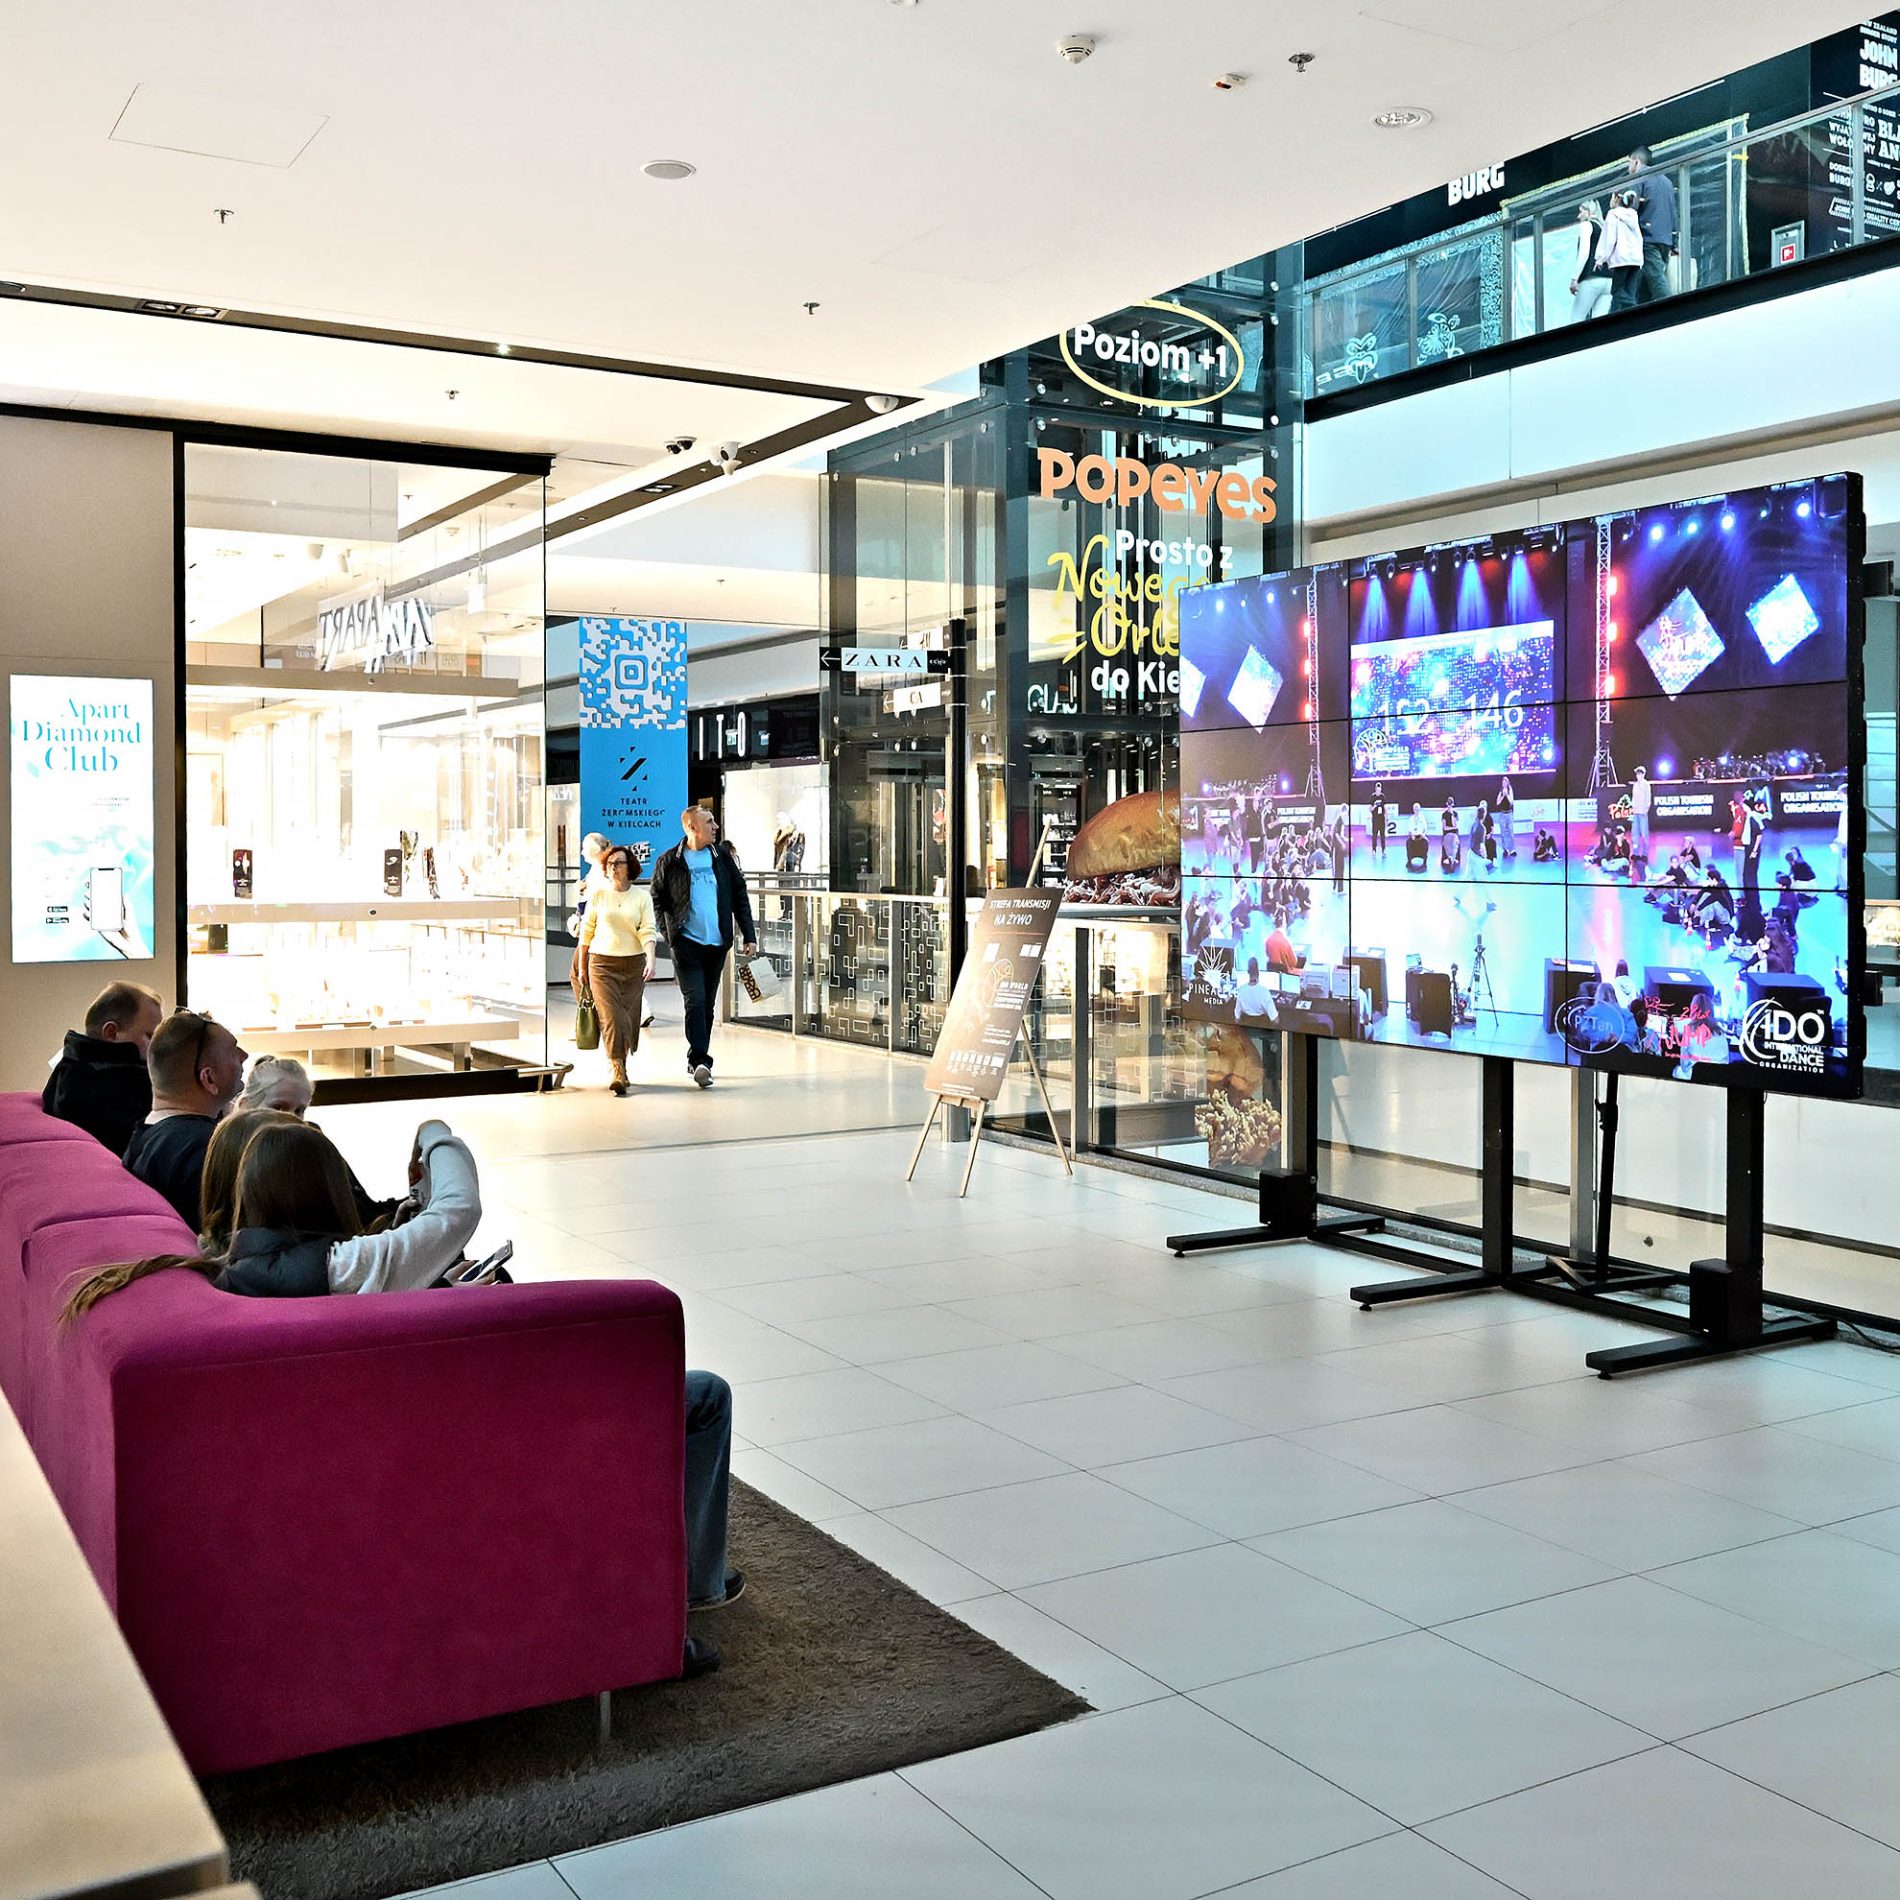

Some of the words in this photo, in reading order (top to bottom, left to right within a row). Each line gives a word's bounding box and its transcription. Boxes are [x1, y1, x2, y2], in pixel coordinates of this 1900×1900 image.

[1859, 38, 1898, 71] JOHN
[1447, 161, 1505, 207] BURG
[1074, 322, 1190, 373] Poziom
[1197, 344, 1227, 378] +1
[1115, 529, 1214, 568] Prosto
[1219, 546, 1233, 569] z
[844, 652, 923, 668] ZARA
[1090, 659, 1130, 693] do
[60, 698, 130, 725] Apart
[1465, 689, 1524, 729] 146
[23, 720, 141, 744] Diamond
[45, 746, 119, 771] Club
[620, 797, 648, 806] TEATR
[618, 820, 662, 829] KIELCACH
[1387, 821, 1397, 835] 2
[989, 898, 1012, 910] STREFA
[1011, 898, 1052, 911] TRANSMISJI
[993, 914, 1008, 926] NA
[1007, 911, 1034, 926] ŻYWO
[1203, 997, 1223, 1006] MEDIA
[1763, 1041, 1824, 1055] INTERNATIONAL
[1759, 1060, 1824, 1074] ORGANIZATION
[1780, 1051, 1824, 1067] DANCE
